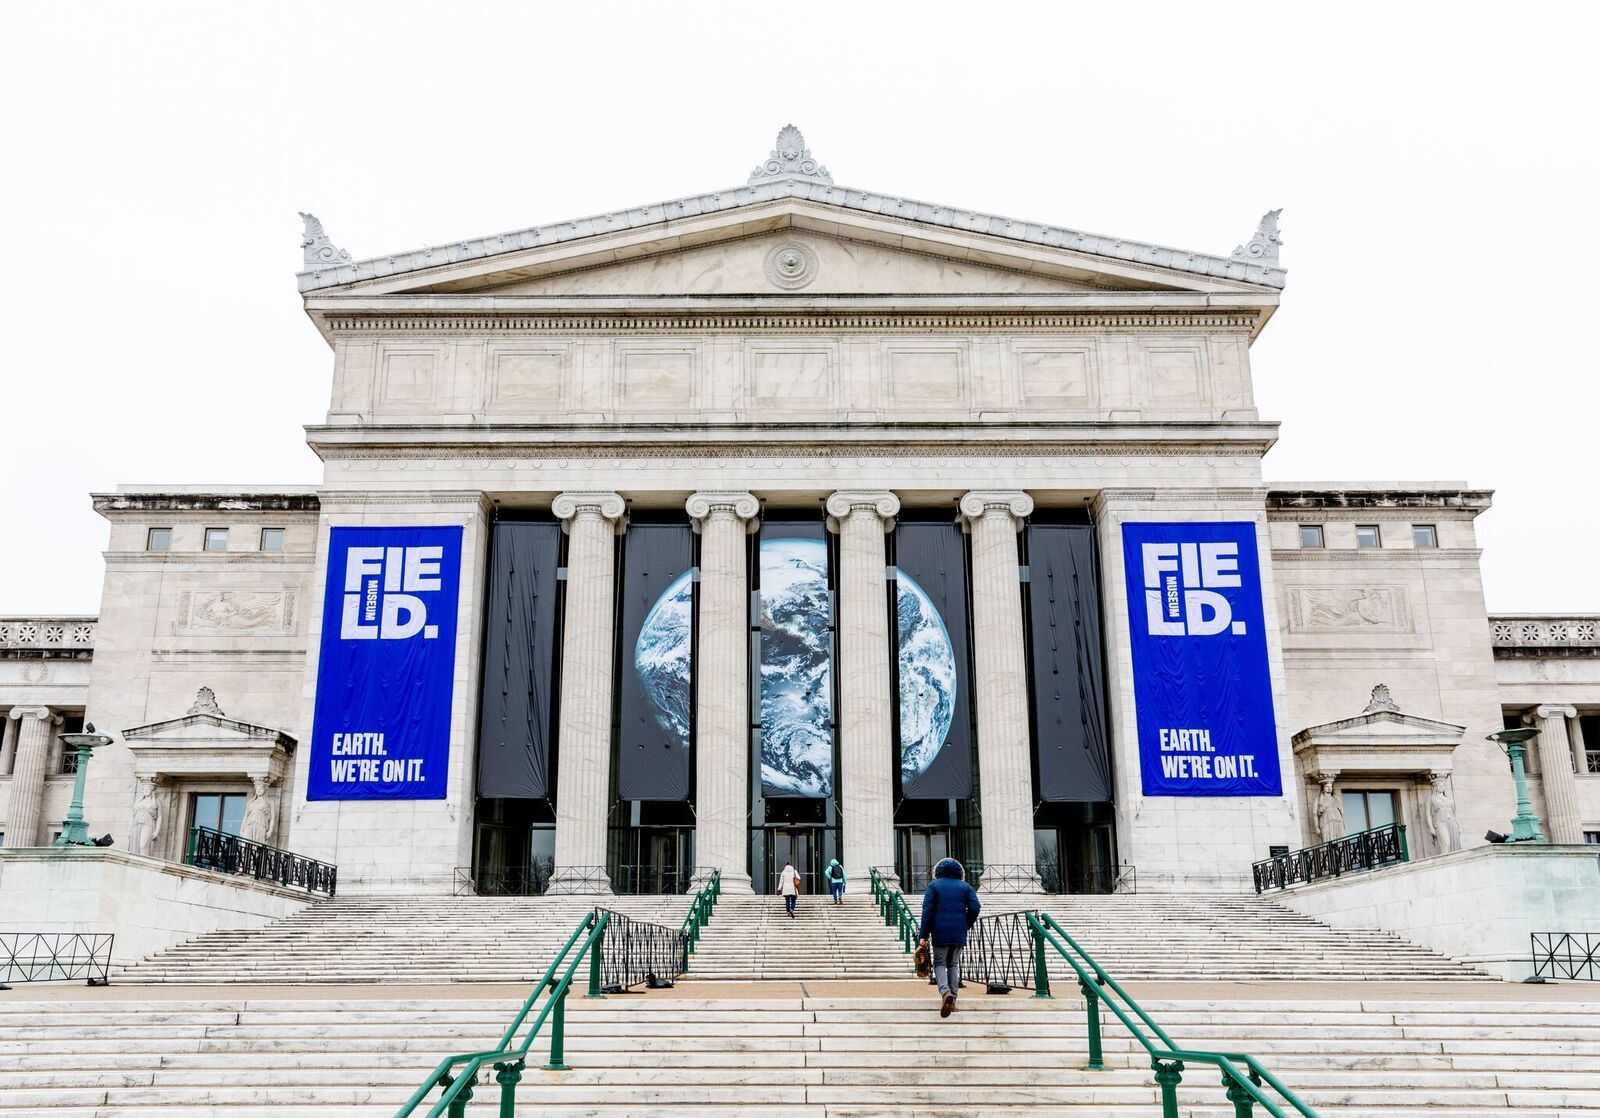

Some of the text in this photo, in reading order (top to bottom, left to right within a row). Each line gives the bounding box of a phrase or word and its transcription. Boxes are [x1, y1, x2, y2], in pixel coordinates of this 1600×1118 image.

[364, 579, 379, 621] MUSEUM
[1165, 576, 1180, 618] MUSEUM
[332, 732, 387, 756] EARTH.
[1159, 728, 1216, 752] EARTH.
[330, 758, 426, 783] WE'RE ON IT.
[1160, 754, 1259, 779] WE'RE ON IT.
